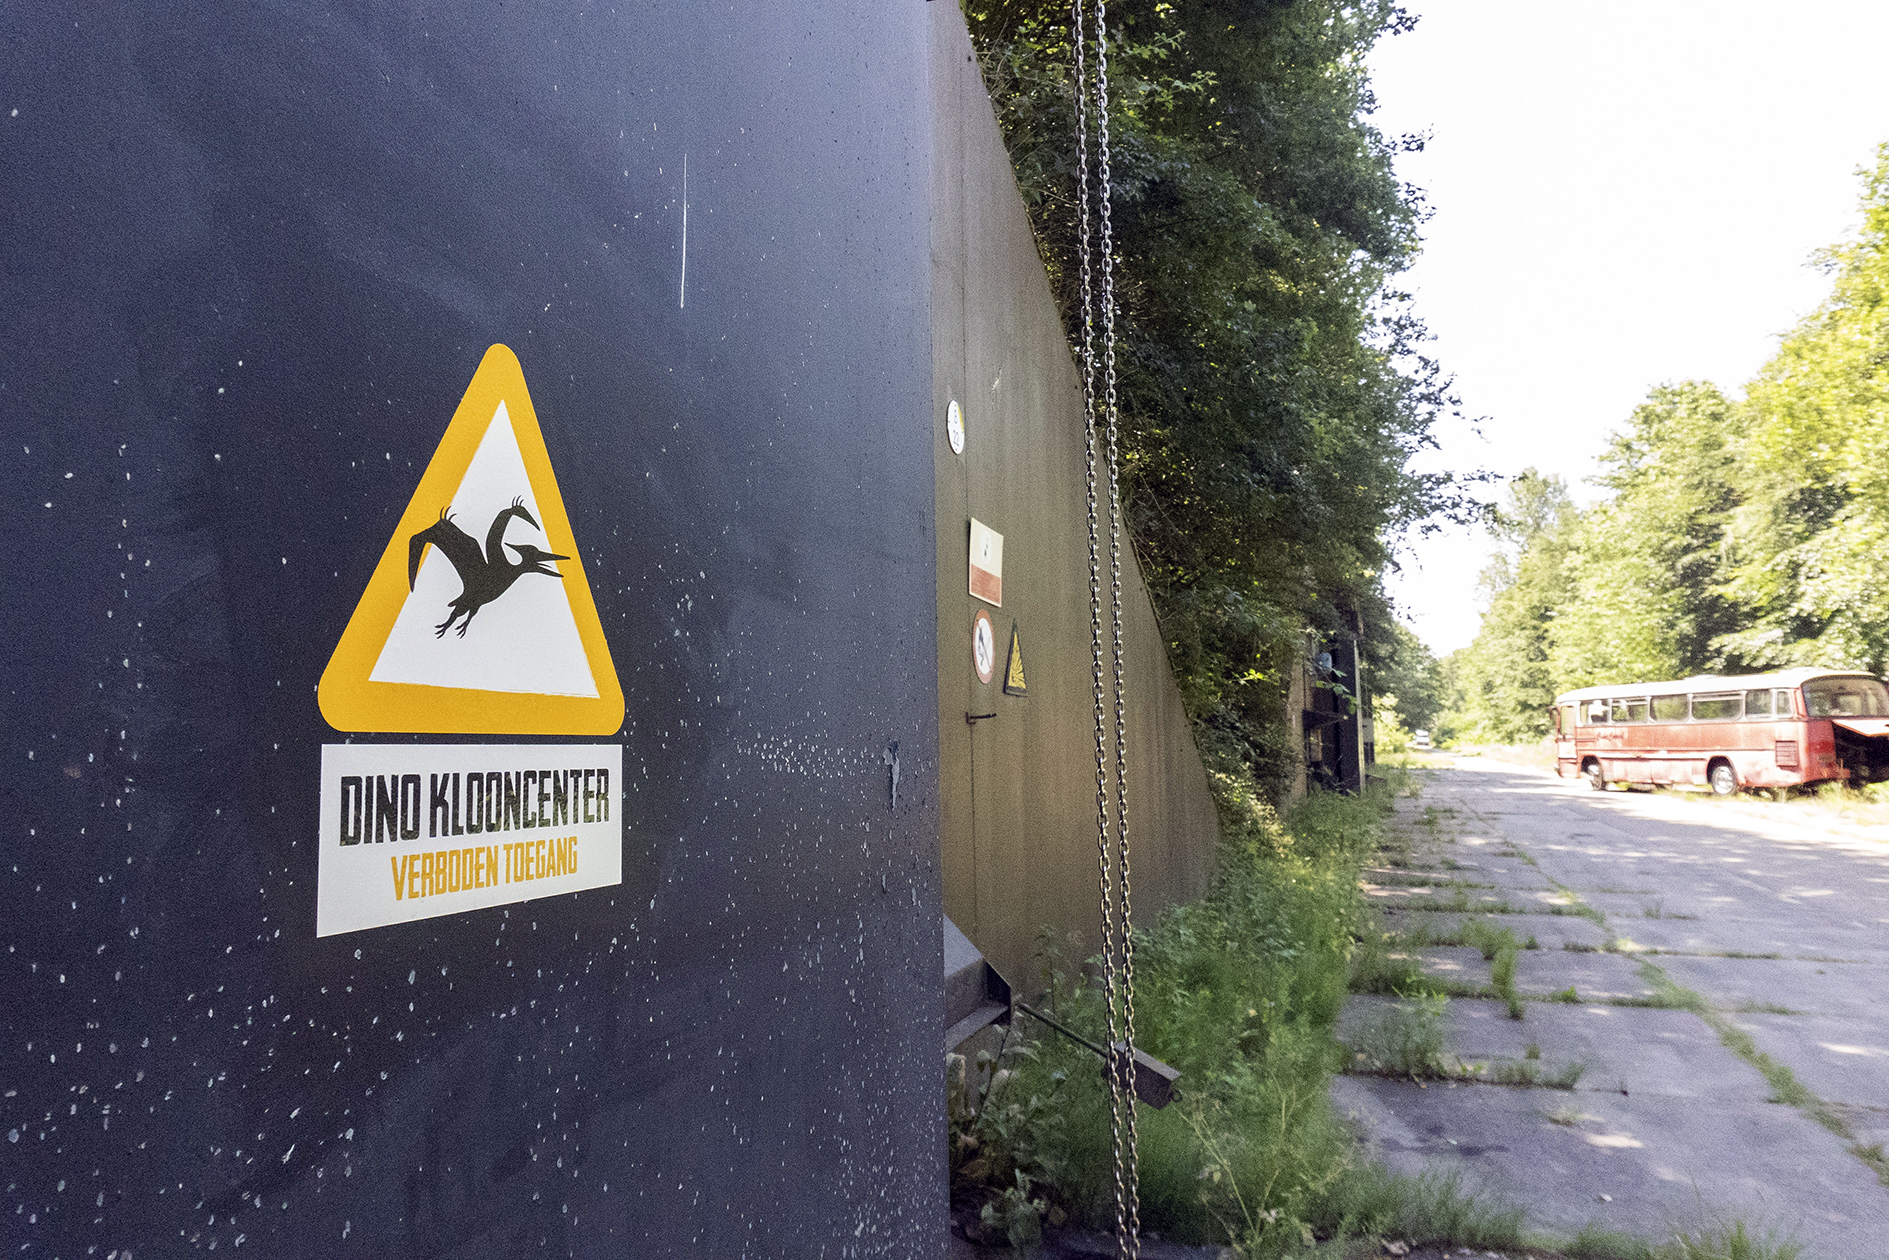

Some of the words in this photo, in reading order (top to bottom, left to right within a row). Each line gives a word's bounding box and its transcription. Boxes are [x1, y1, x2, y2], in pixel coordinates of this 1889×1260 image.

[339, 774, 421, 847] DINO
[429, 768, 610, 838] KLOONCENTER
[390, 846, 499, 901] VERBODEN
[503, 836, 578, 884] TOEGANG
